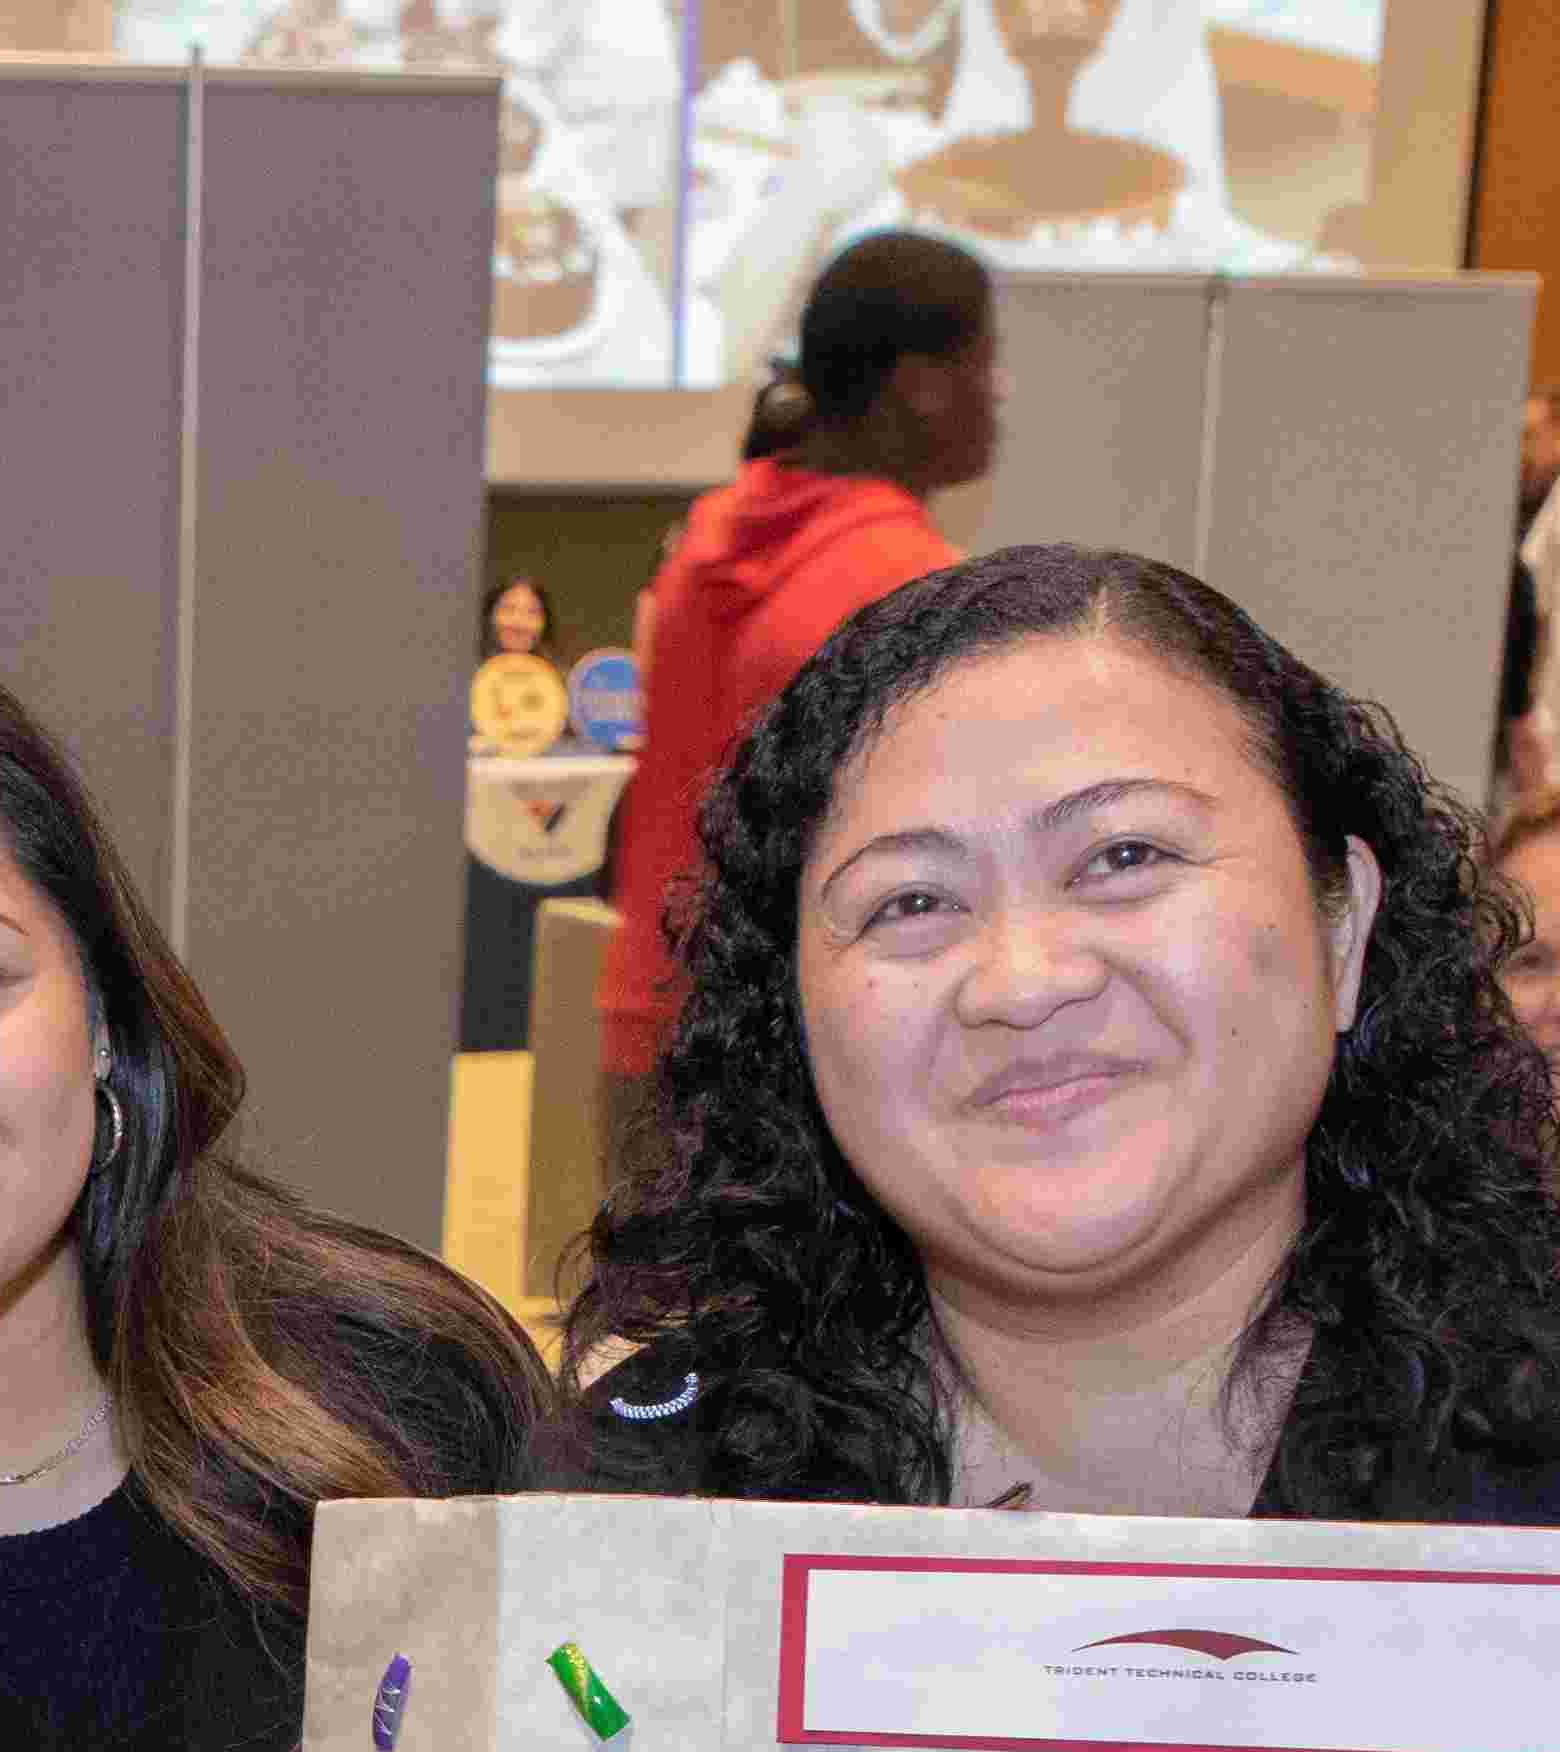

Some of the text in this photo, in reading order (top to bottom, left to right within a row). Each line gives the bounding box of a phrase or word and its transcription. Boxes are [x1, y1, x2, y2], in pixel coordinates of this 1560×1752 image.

[1044, 1665, 1318, 1683] TRIDENT TECHNICAL COLLEGE
